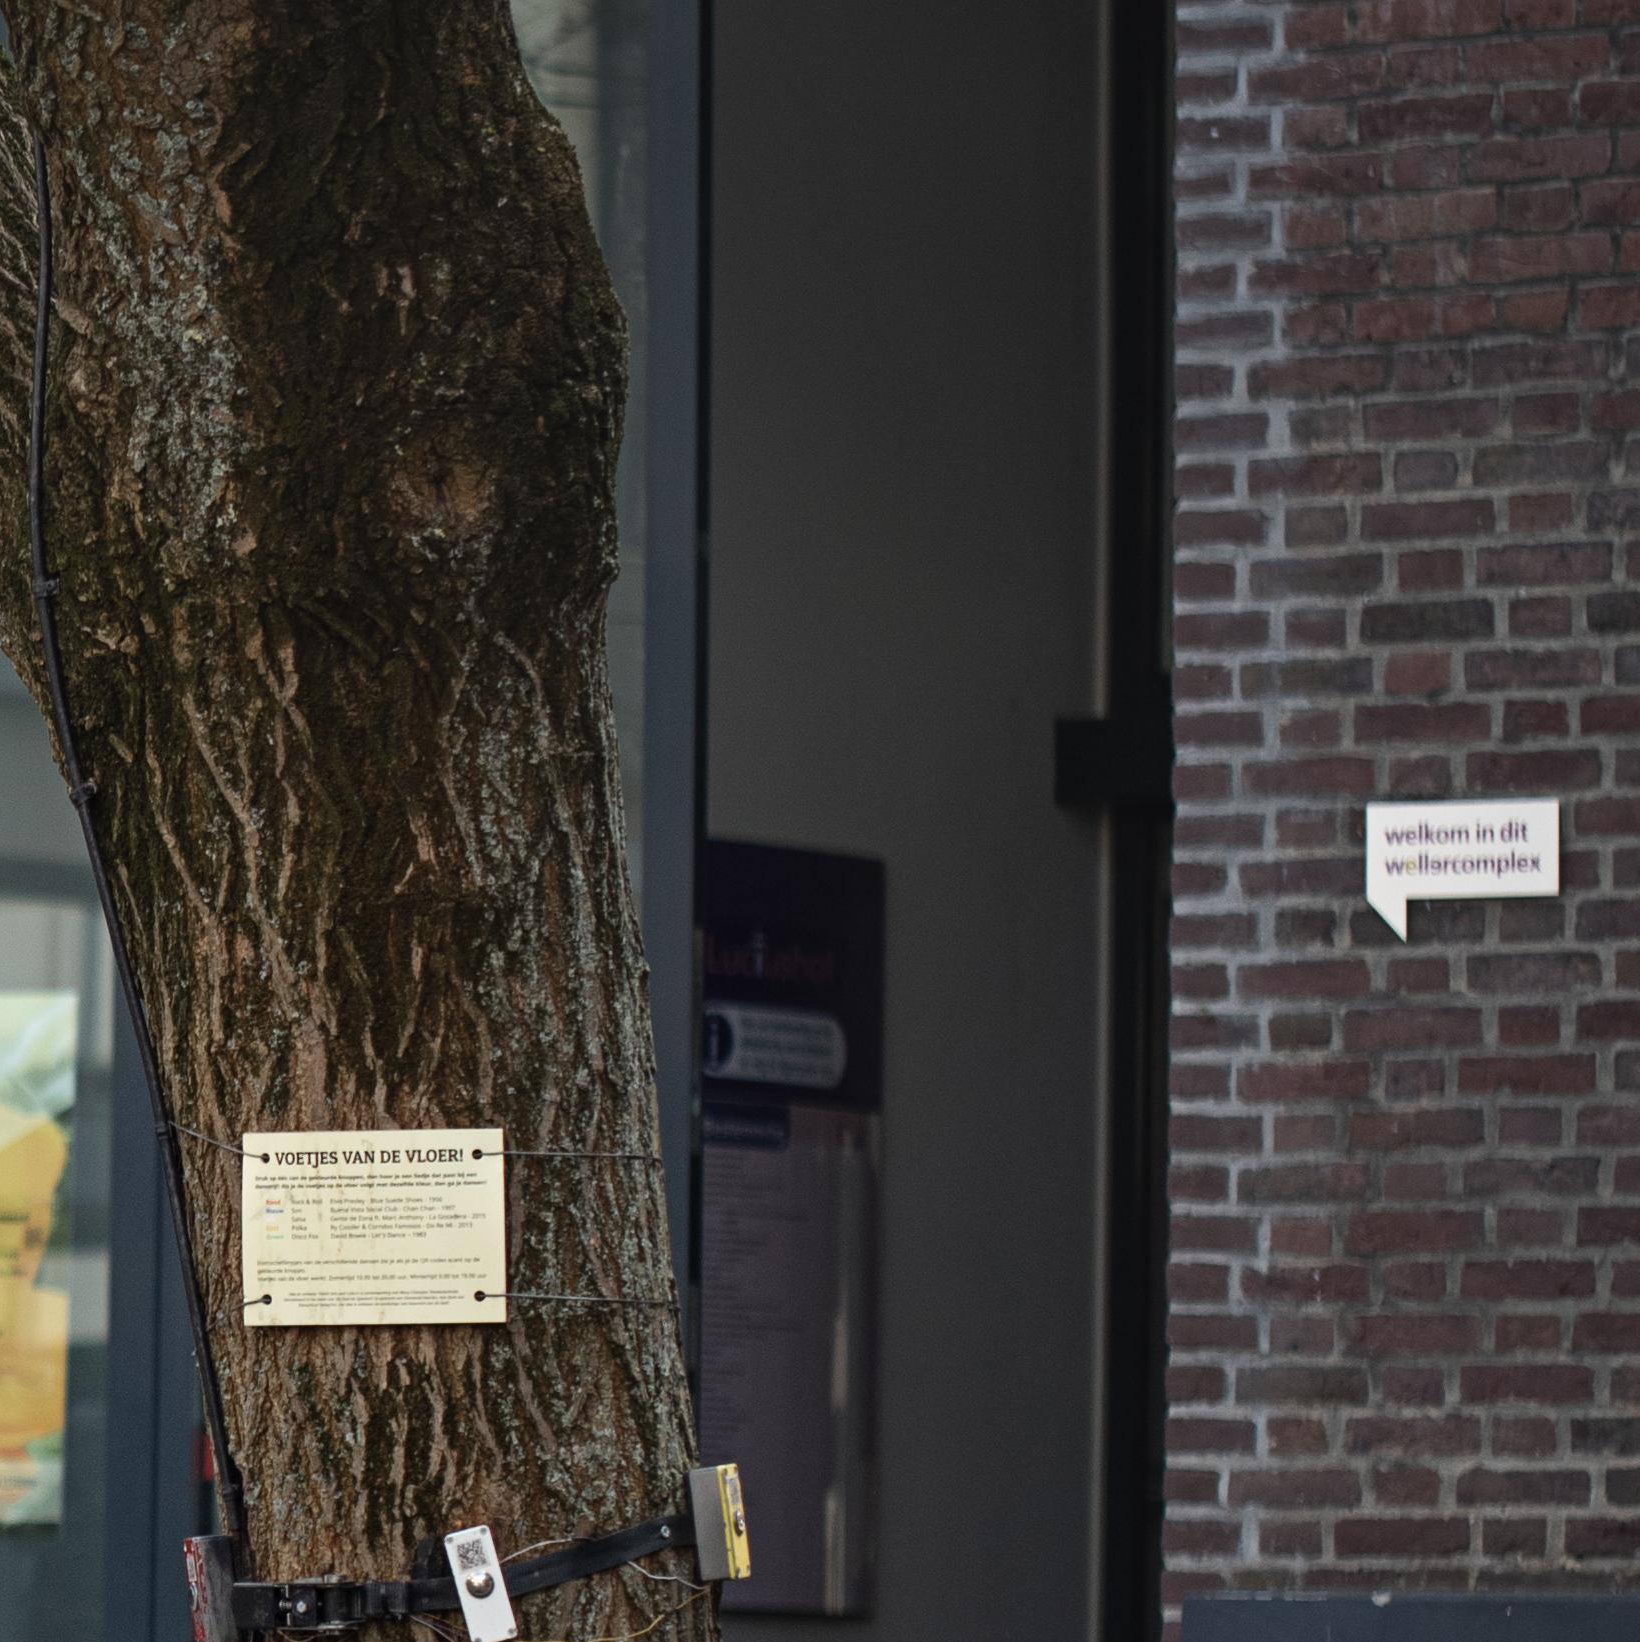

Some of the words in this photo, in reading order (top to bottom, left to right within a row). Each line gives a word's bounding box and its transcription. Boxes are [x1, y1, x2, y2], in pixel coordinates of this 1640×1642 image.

[1385, 823, 1470, 845] welkom
[1476, 822, 1494, 842] in
[1500, 820, 1528, 842] dit
[275, 1151, 338, 1168] VOETJES
[342, 1149, 376, 1165] VAN
[379, 1149, 401, 1164] DE
[405, 1148, 464, 1163] VLOER!
